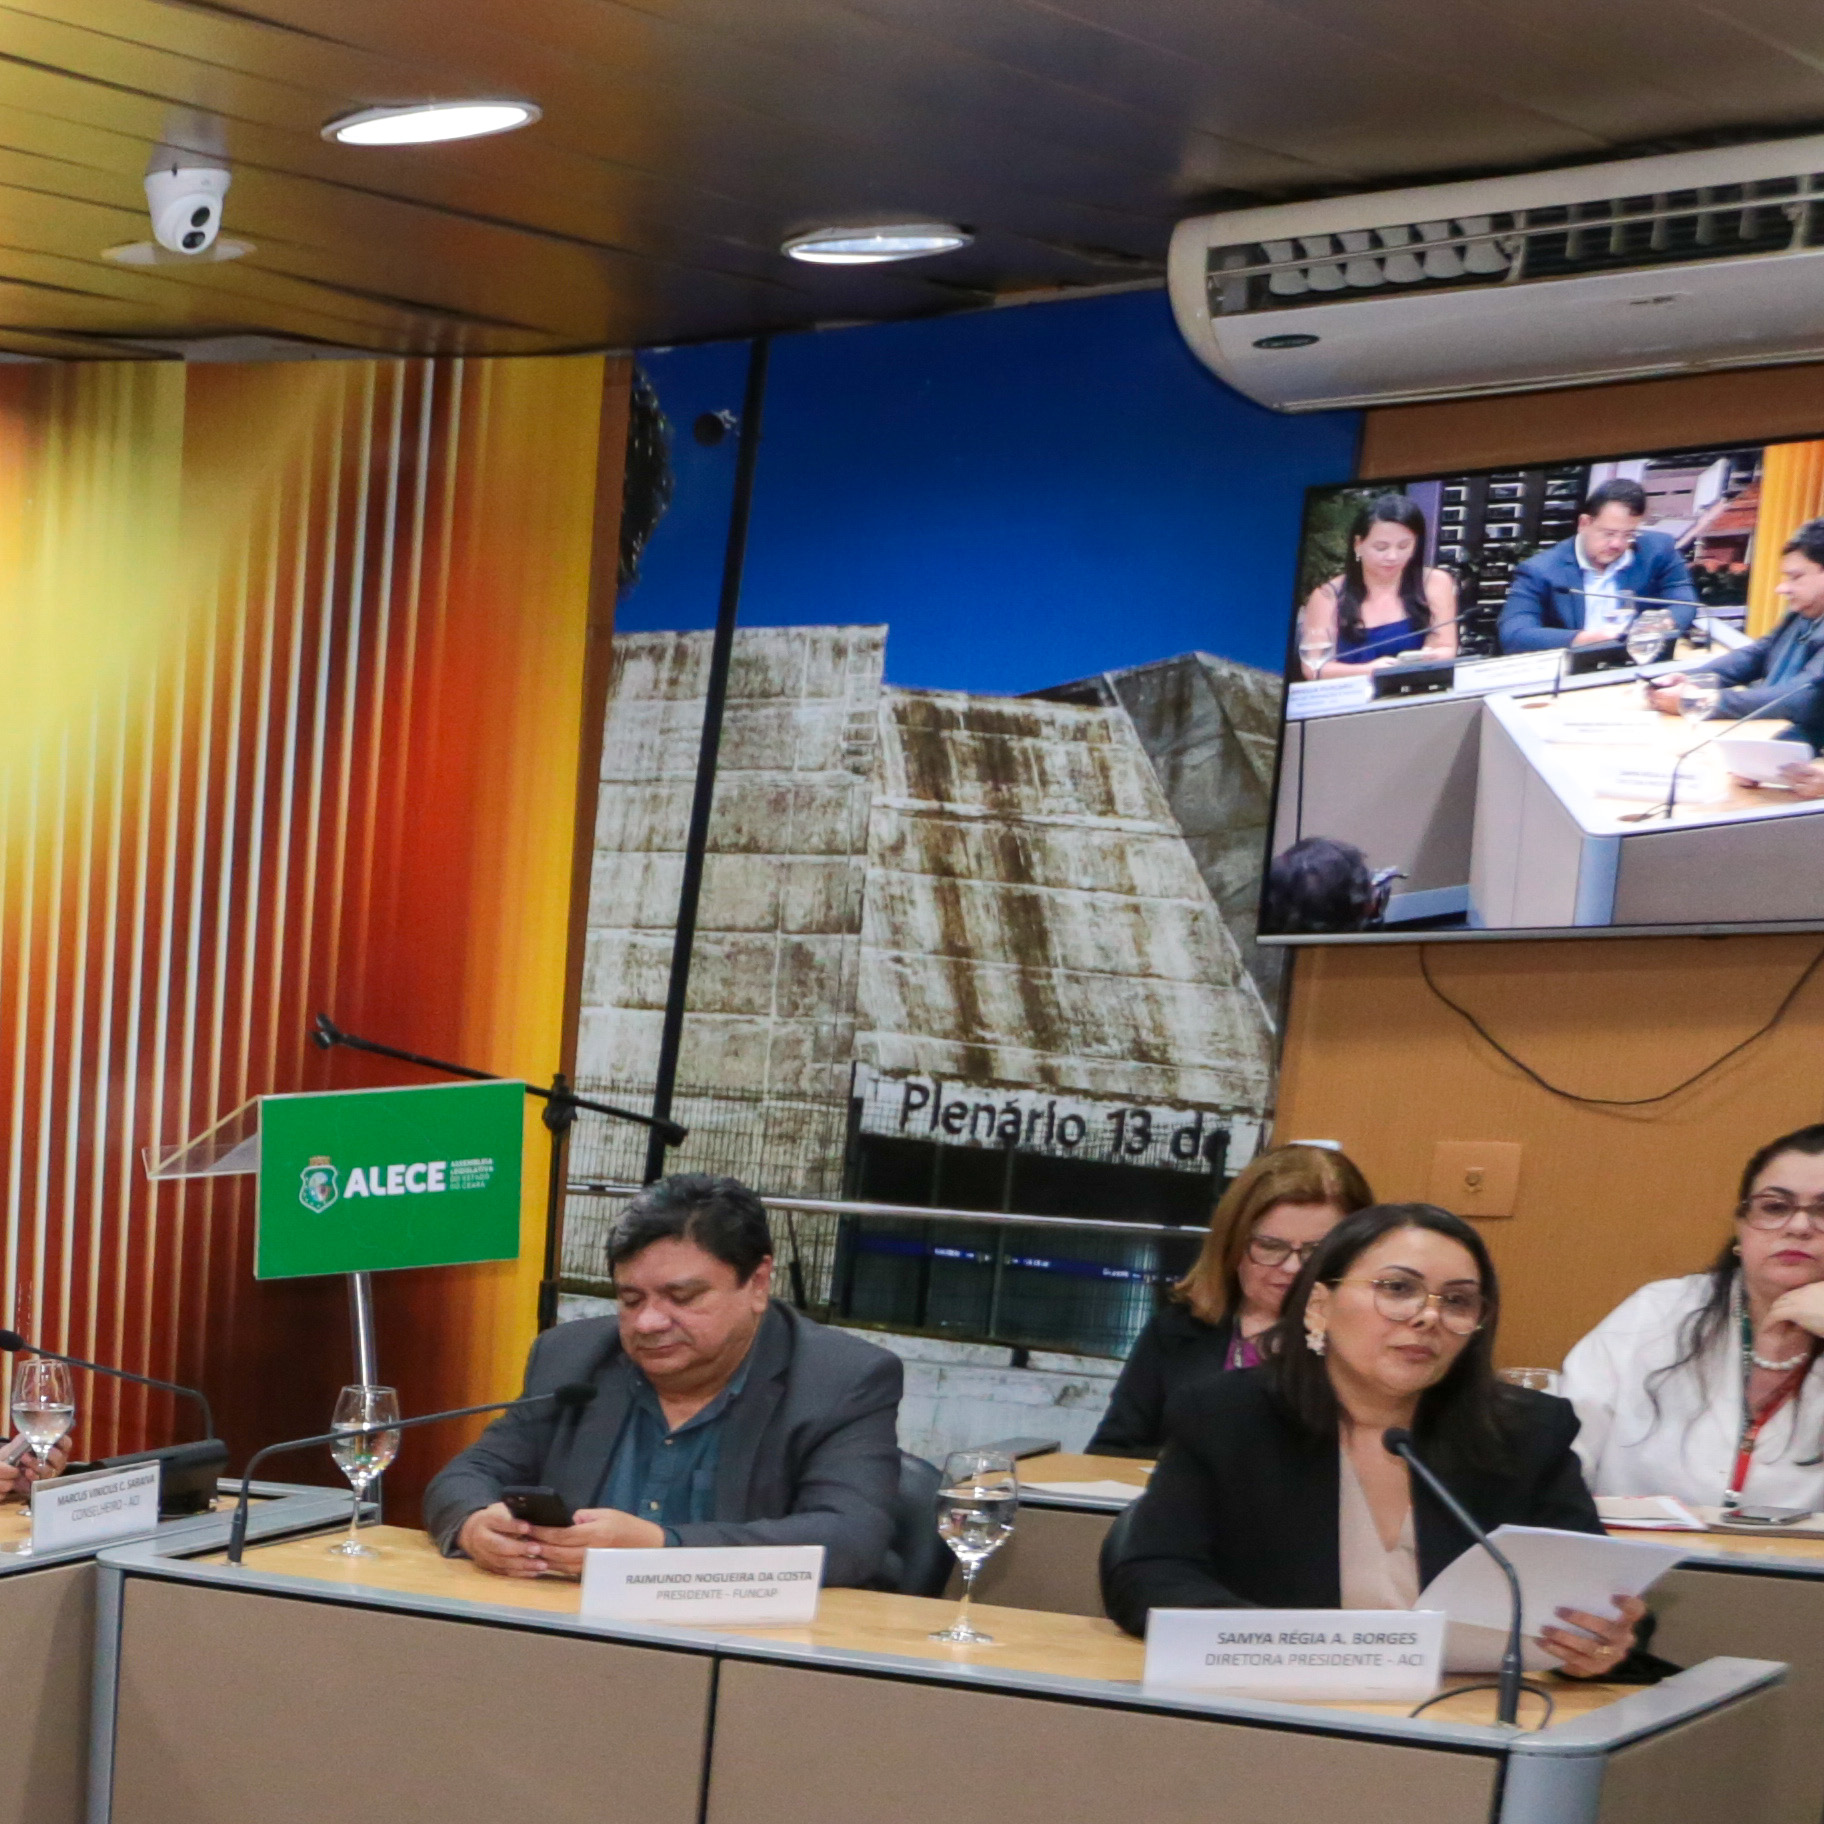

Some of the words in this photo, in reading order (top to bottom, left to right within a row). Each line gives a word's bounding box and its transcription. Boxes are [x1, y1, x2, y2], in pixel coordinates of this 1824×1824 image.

[899, 1080, 1086, 1148] Plenário
[1107, 1107, 1151, 1155] 13
[343, 1161, 447, 1199] ALECE
[57, 1490, 88, 1506] MARCUS
[72, 1499, 122, 1521] CONSELHEIRO
[625, 1574, 692, 1585] RAIMUNDO
[695, 1573, 754, 1584] NOGUEIRA
[758, 1572, 774, 1582] DA
[777, 1571, 812, 1582] COSTA
[656, 1589, 722, 1600] PRESIDENTE
[733, 1588, 778, 1599] FUNCAP
[1217, 1632, 1274, 1645] SAMYA
[1278, 1629, 1325, 1645] RÉGIA
[1329, 1632, 1346, 1645] A.
[1352, 1632, 1418, 1645] BORGES
[1205, 1653, 1283, 1666] DIRETORA
[1288, 1653, 1383, 1666] PRESIDENTE
[1397, 1653, 1424, 1666] ACI
